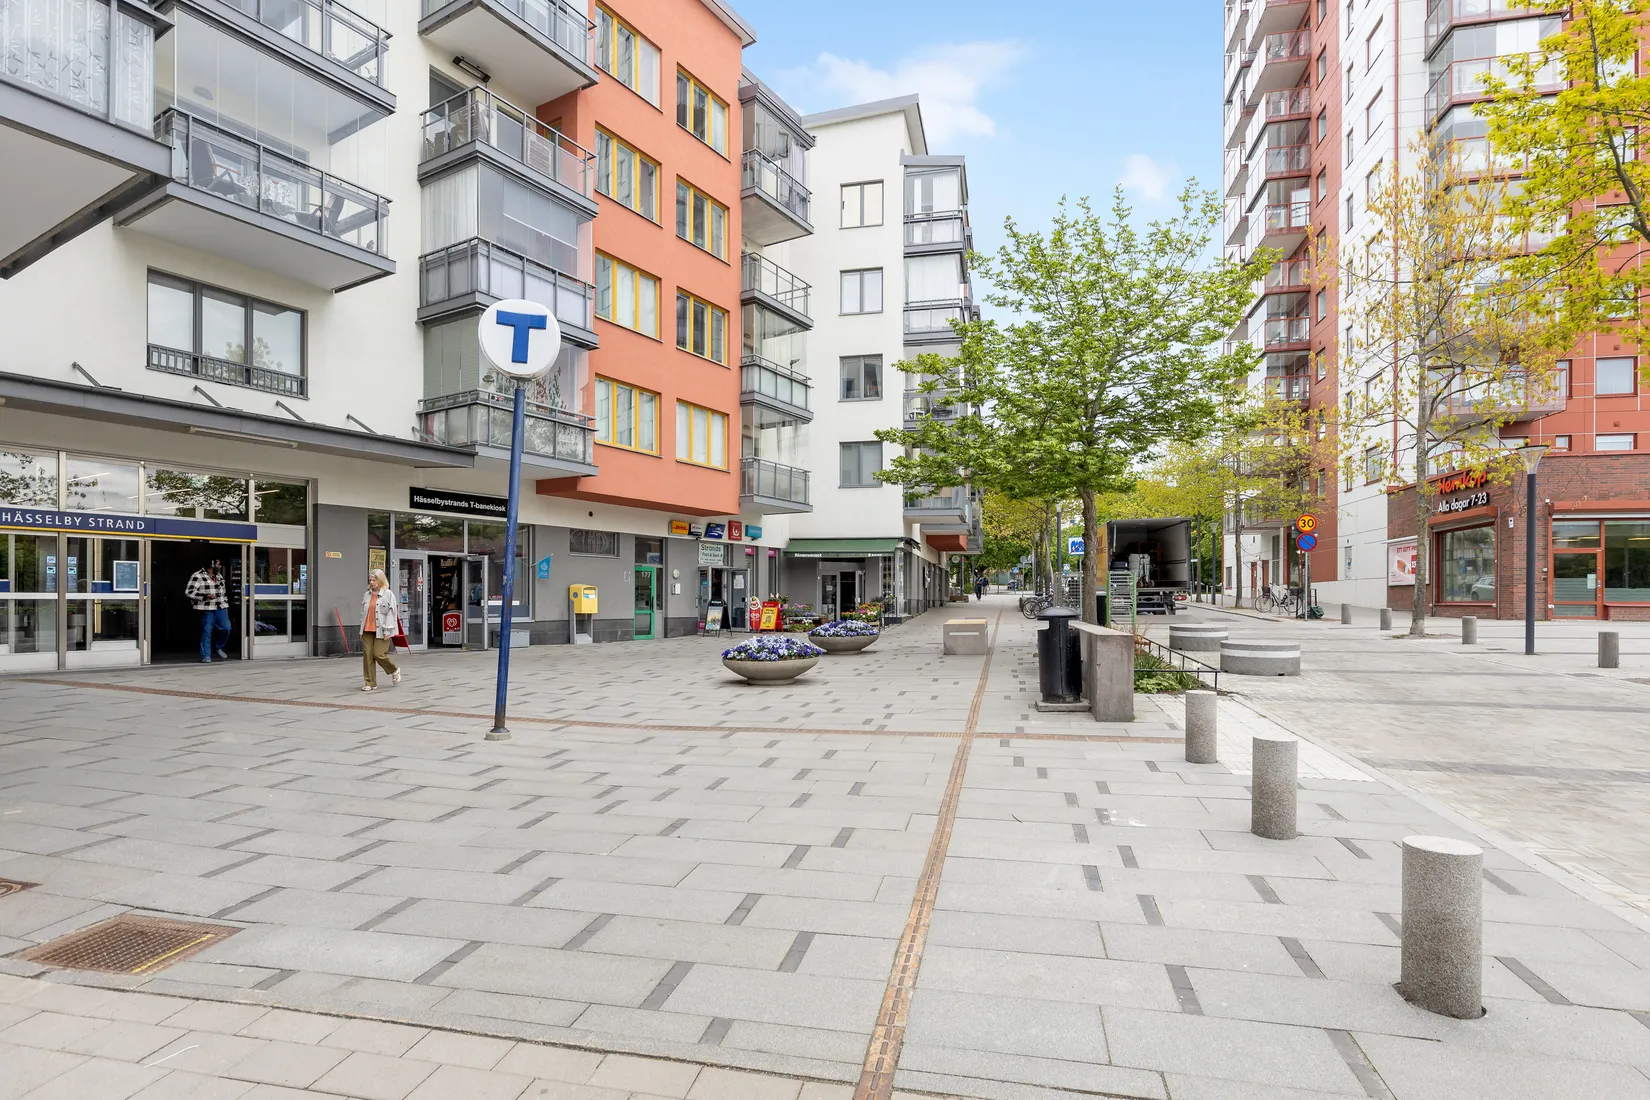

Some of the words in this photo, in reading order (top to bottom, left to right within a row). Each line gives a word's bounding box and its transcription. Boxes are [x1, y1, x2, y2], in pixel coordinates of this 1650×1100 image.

[496, 309, 547, 364] T
[1437, 471, 1487, 496] Hemkp
[413, 495, 469, 509] Hässelbystrands
[469, 501, 507, 513] T-banekiosk
[1438, 501, 1450, 513] Alla
[1450, 498, 1470, 512] dagar
[1471, 492, 1487, 506] 7-23
[2, 511, 82, 526] HÄSSELBY
[88, 517, 146, 530] STRAND
[1300, 518, 1315, 528] 30
[701, 543, 722, 552] Strands
